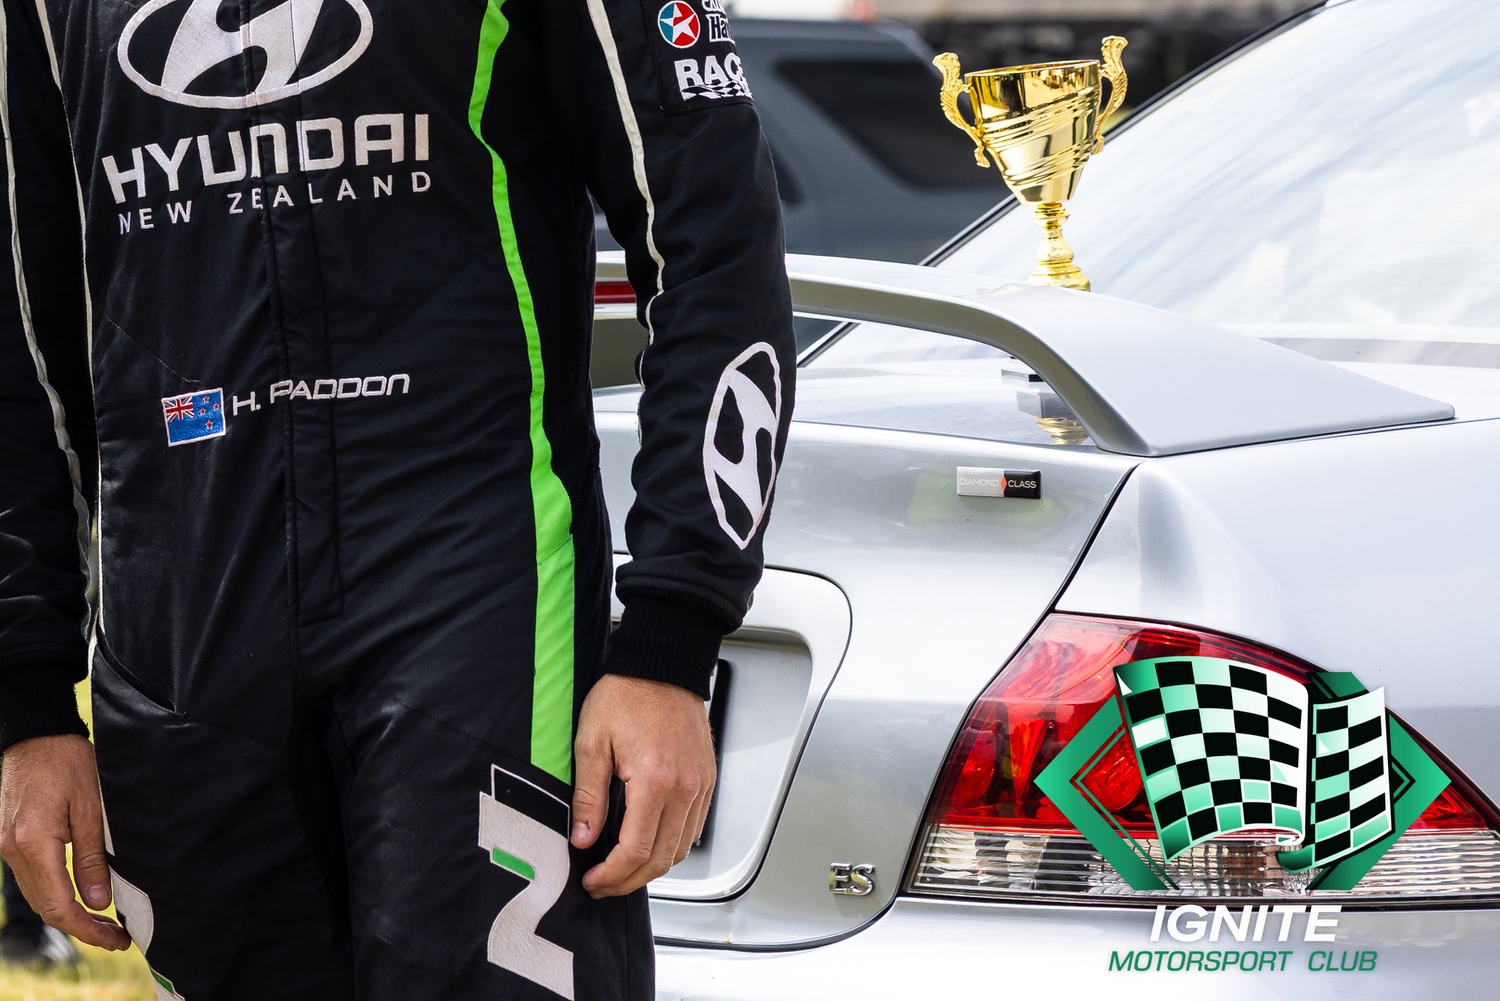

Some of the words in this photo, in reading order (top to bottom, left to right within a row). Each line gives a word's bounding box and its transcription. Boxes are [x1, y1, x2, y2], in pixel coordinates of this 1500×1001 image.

[101, 113, 430, 205] HYUNDAI
[118, 200, 193, 235] NEW
[227, 171, 432, 214] ZEALAND
[232, 391, 261, 416] H.
[270, 373, 411, 404] PADDON
[959, 478, 1000, 487] DIAMOND
[1007, 479, 1037, 489] CLASS
[828, 862, 876, 896] ES
